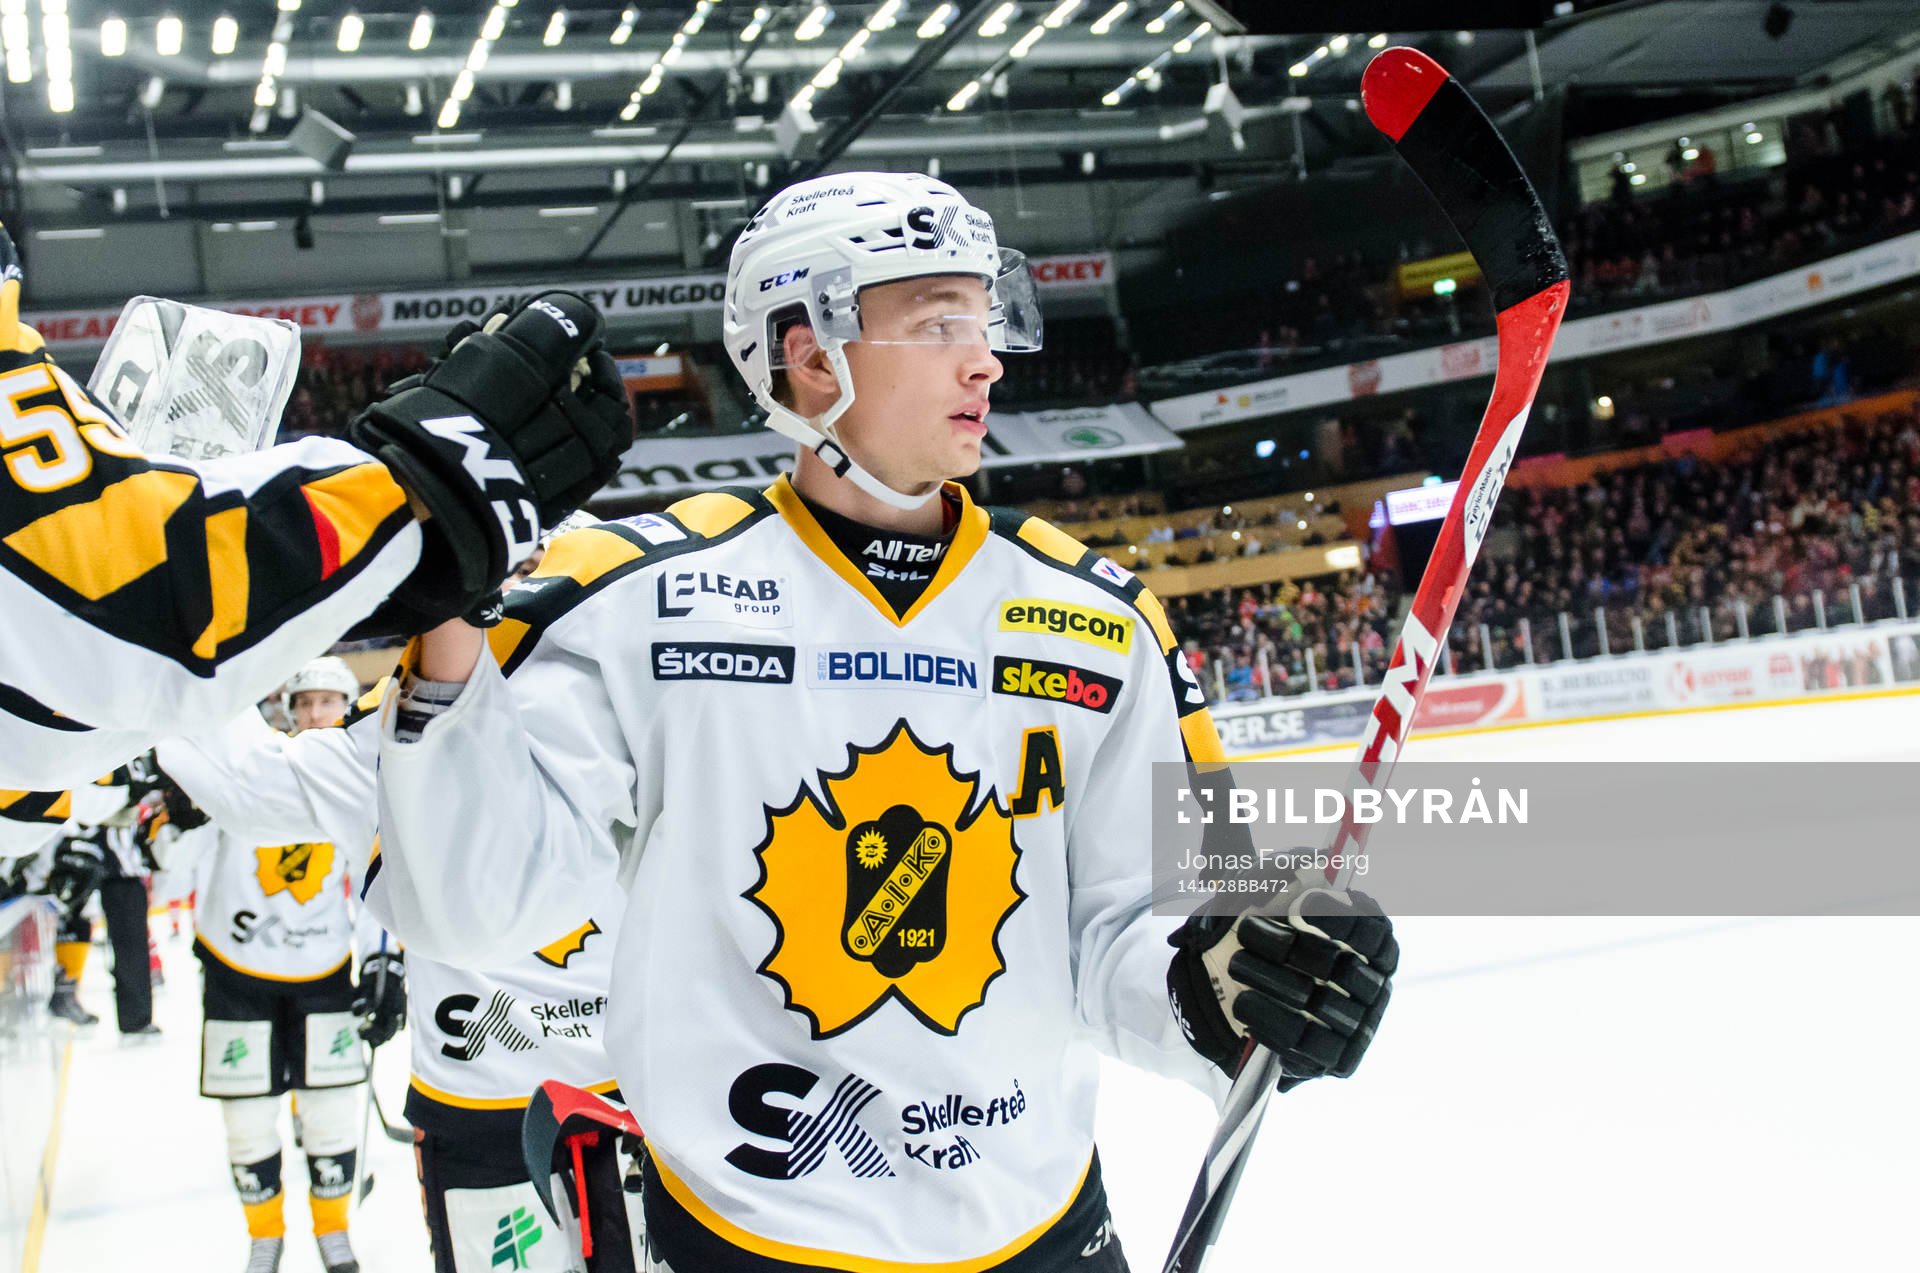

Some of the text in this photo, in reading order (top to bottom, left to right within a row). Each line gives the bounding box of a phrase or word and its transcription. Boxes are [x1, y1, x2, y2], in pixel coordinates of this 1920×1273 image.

[791, 185, 855, 205] Skellefteå
[786, 204, 817, 218] Kraft
[758, 266, 811, 293] CCM
[393, 300, 488, 321] MODO
[700, 571, 780, 601] LEAB
[734, 602, 781, 617] group
[1005, 605, 1124, 644] engcon
[657, 647, 787, 678] ŠKODA
[828, 651, 978, 689] BOLIDEN
[1001, 661, 1109, 708] skebo
[1007, 725, 1065, 820] A
[897, 928, 936, 948] 1921
[901, 1078, 1026, 1135] Skellefteå
